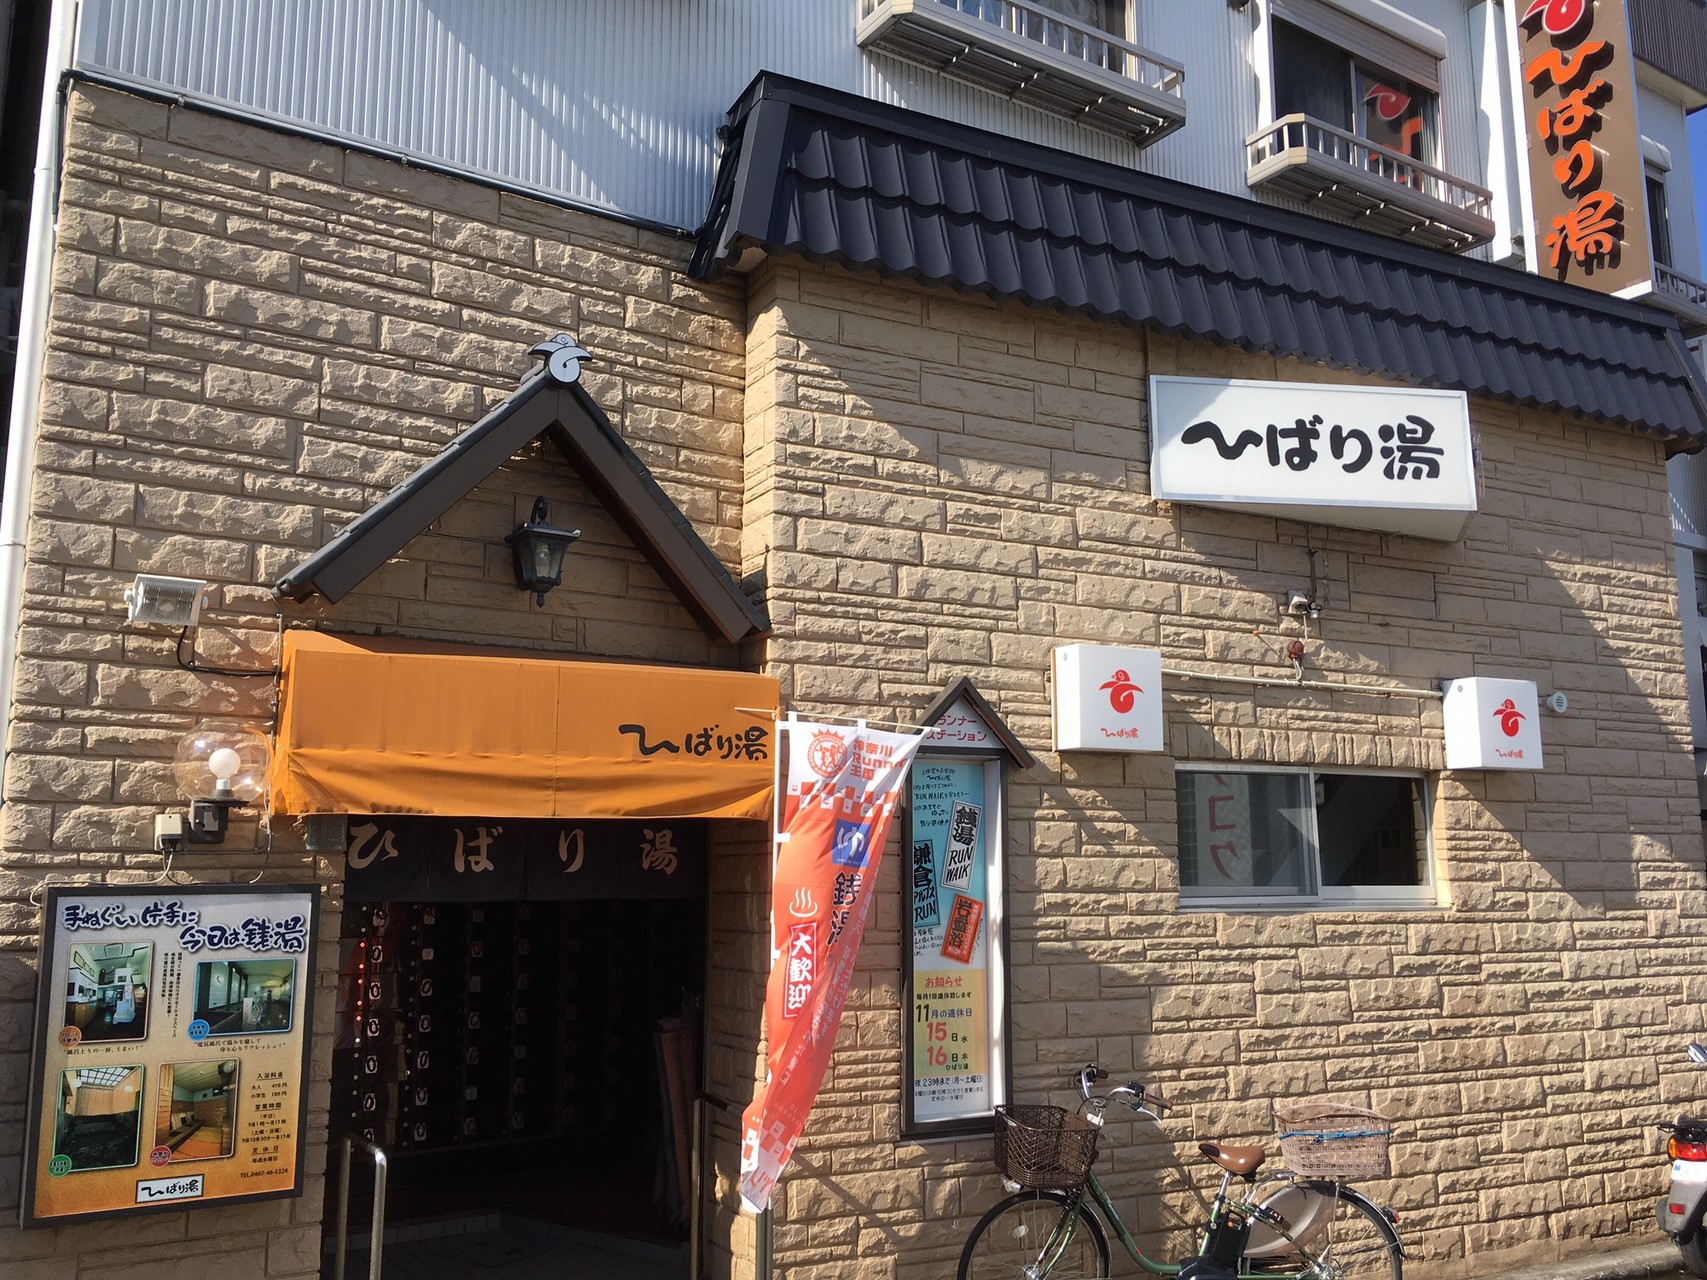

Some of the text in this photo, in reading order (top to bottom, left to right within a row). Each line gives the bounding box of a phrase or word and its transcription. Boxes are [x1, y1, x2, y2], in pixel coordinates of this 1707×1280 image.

[1526, 40, 1617, 268] ひばり湯
[1181, 413, 1444, 480] ひばり湯
[618, 723, 769, 761] ひばり湯
[853, 739, 894, 757] 神奈川
[926, 729, 987, 742] ステーション
[850, 765, 875, 780] 王国
[953, 806, 978, 846] 銭湯
[349, 822, 679, 875] ひばり湯
[837, 826, 866, 858] ゆ
[948, 846, 974, 867] RUN
[914, 900, 938, 923] RUN
[179, 916, 304, 950] 今日は銭湯
[925, 975, 962, 988] お知らせ
[141, 1179, 199, 1197] ひばり湯
